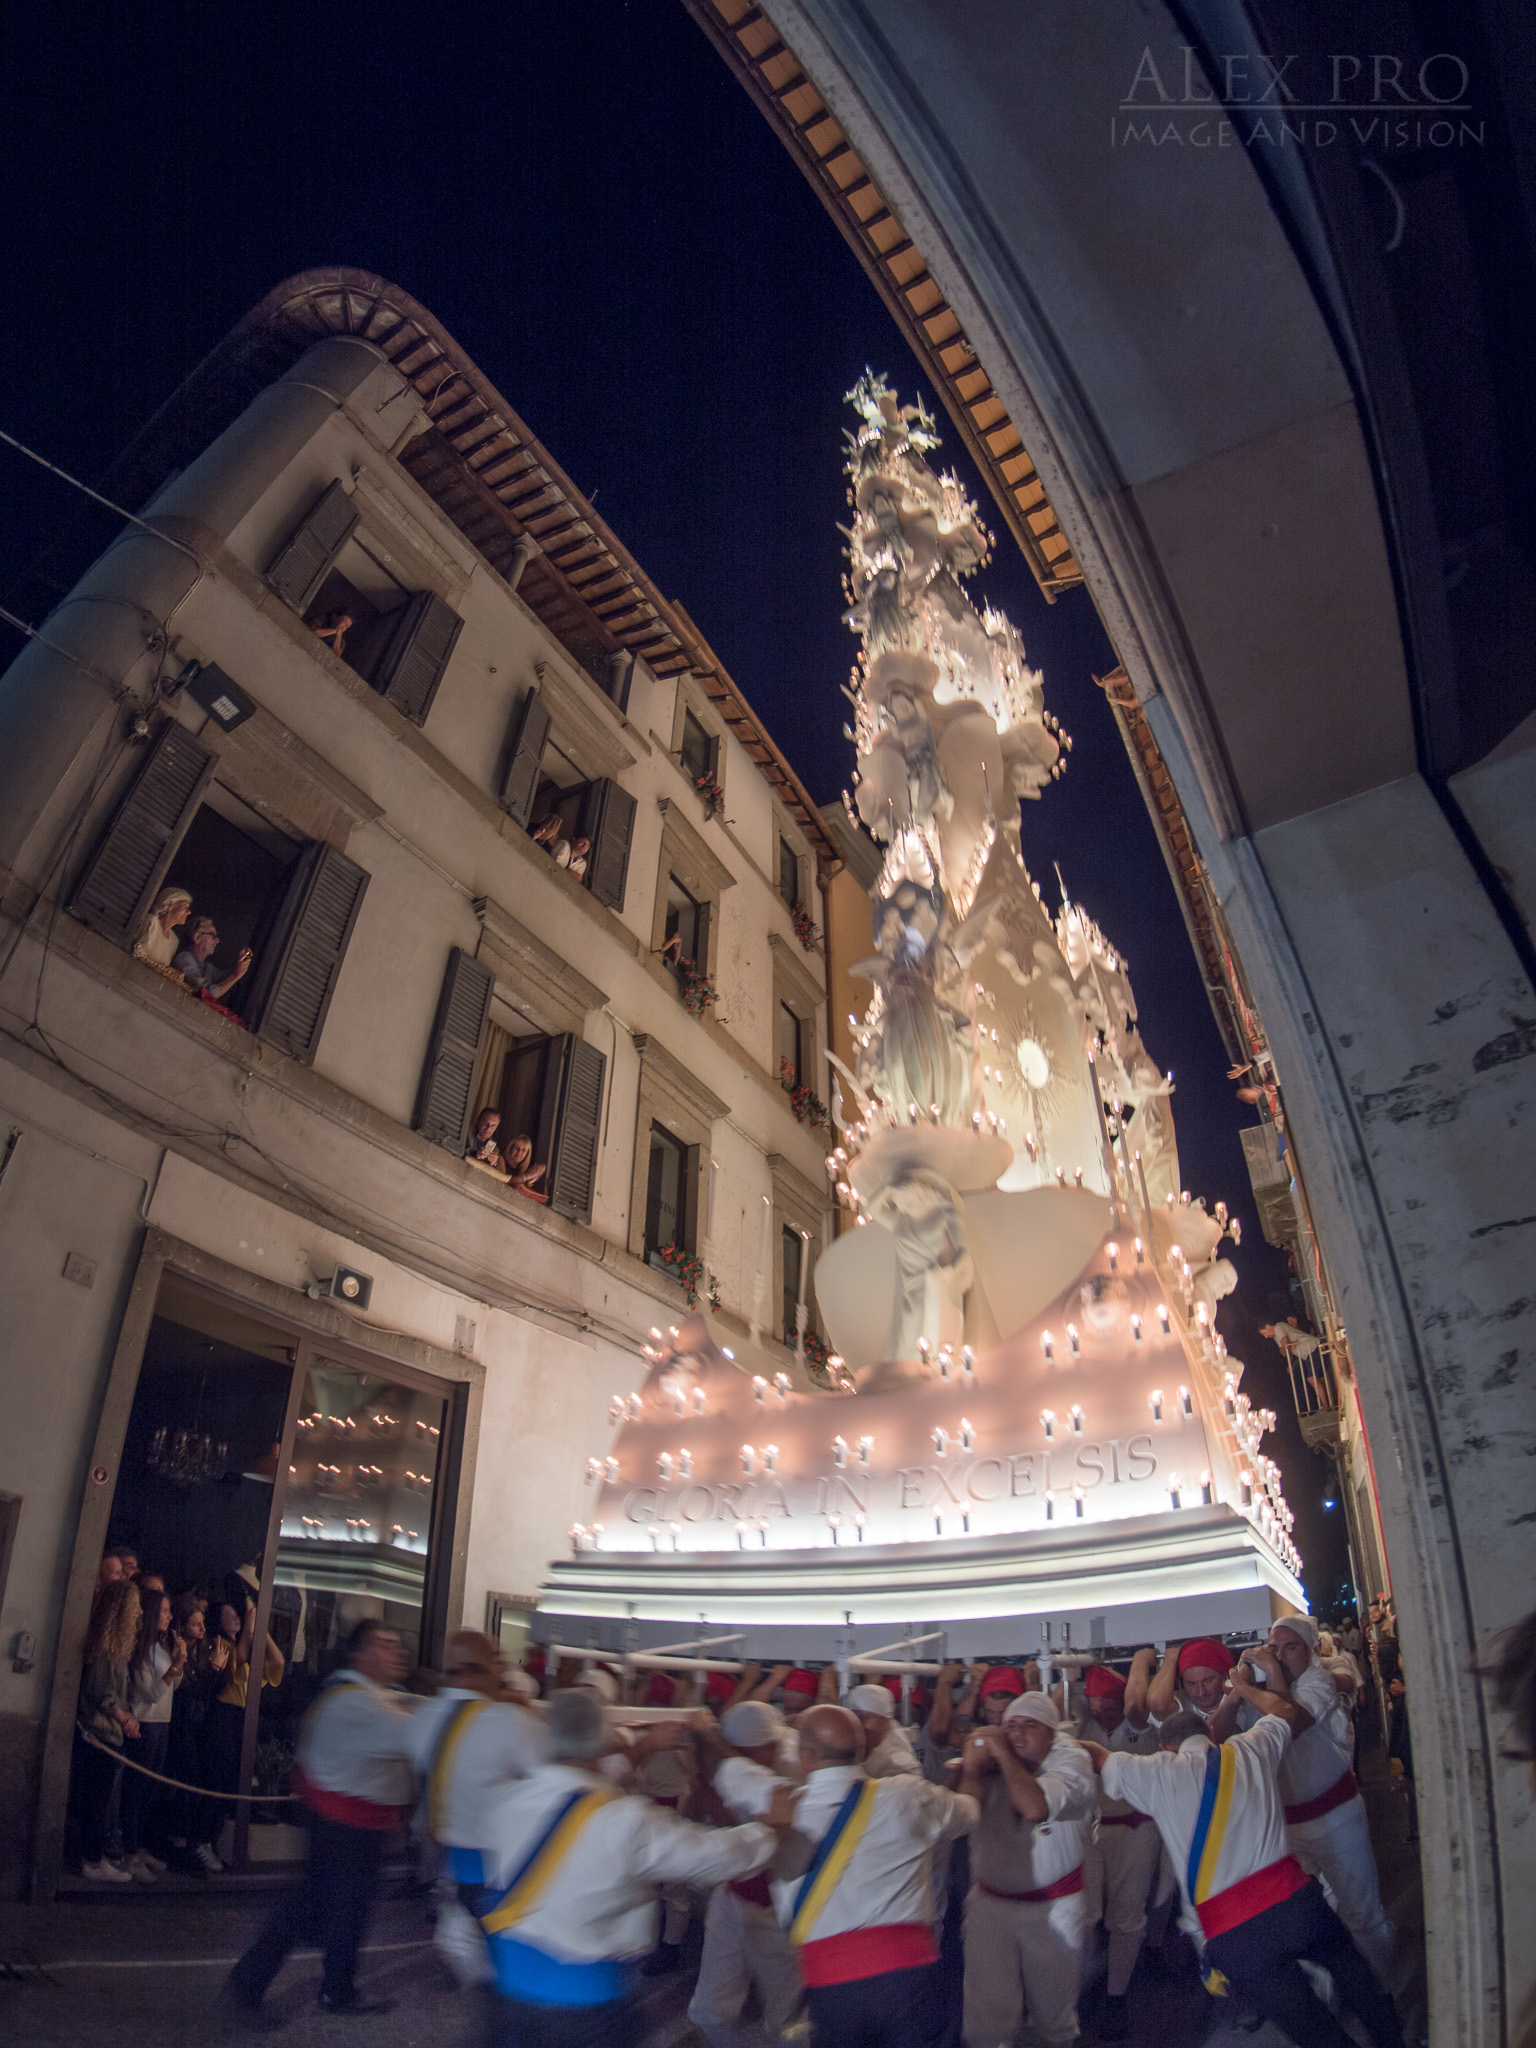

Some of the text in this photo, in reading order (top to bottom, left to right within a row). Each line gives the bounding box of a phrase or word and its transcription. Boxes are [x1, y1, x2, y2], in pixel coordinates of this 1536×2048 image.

[623, 1434, 1158, 1523] GLORIA IN EXCELSIS
